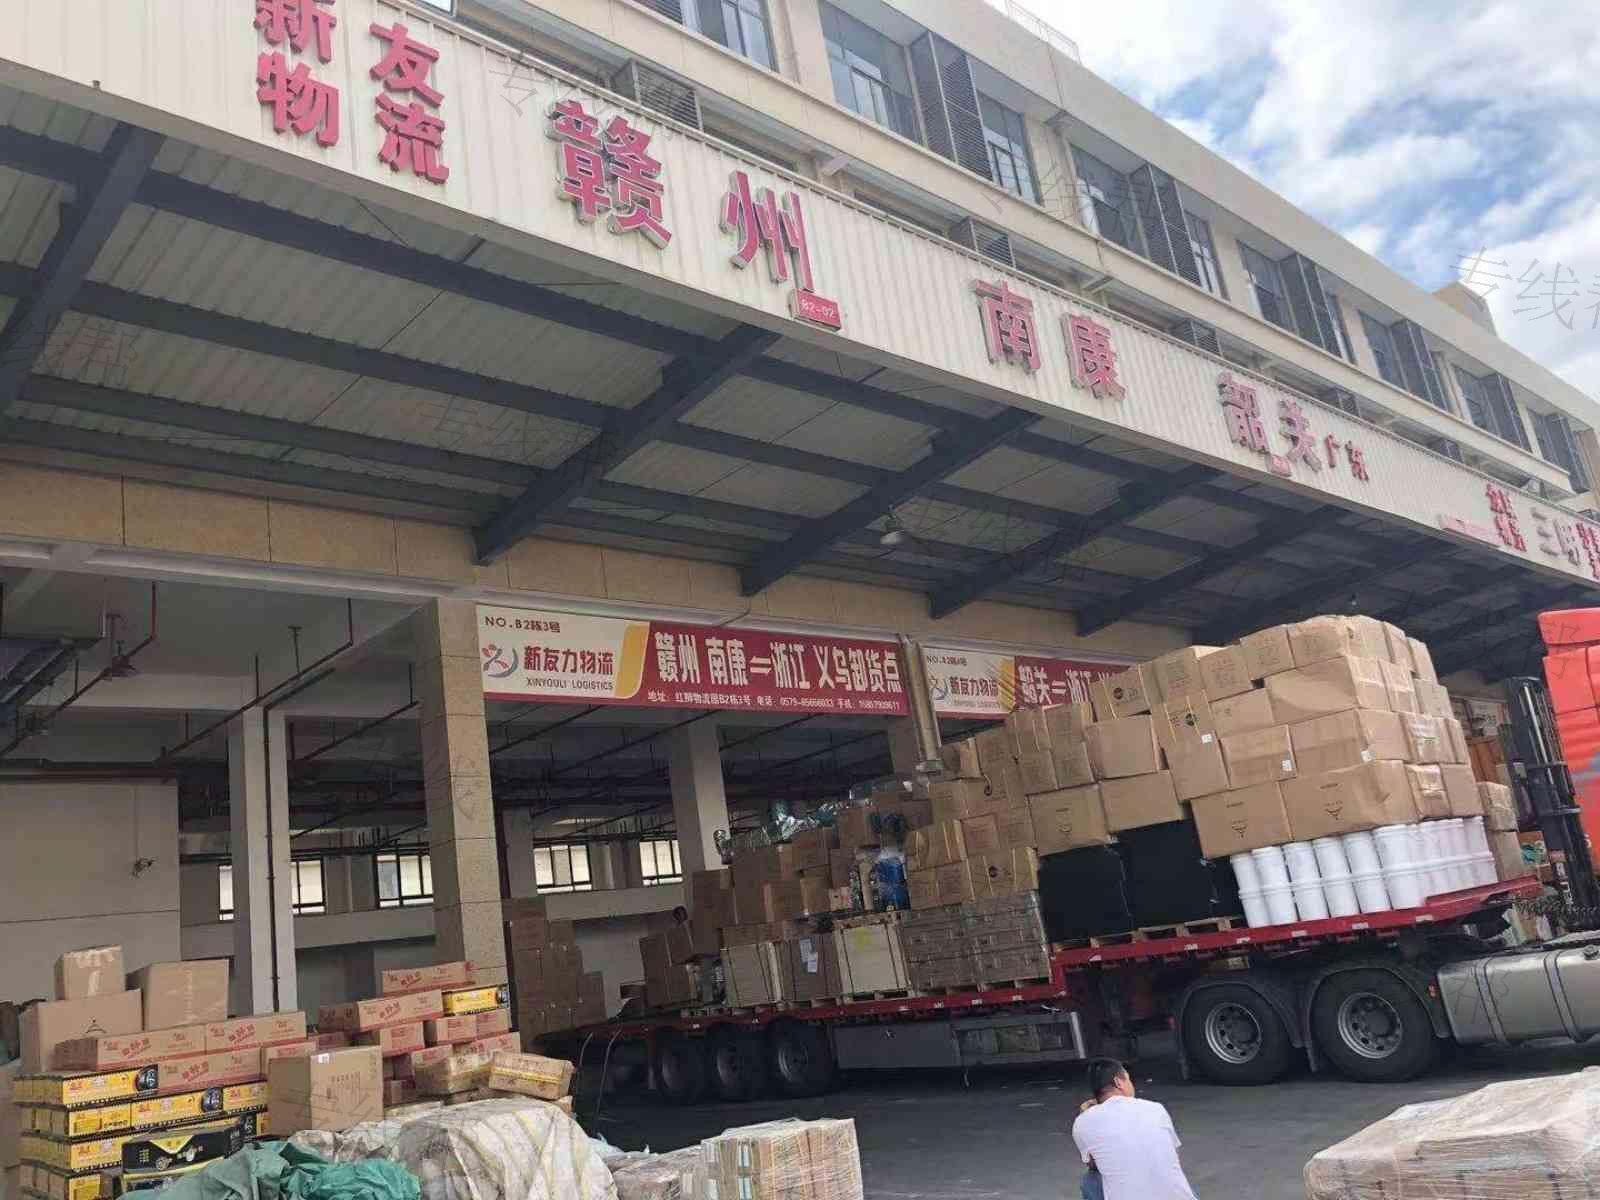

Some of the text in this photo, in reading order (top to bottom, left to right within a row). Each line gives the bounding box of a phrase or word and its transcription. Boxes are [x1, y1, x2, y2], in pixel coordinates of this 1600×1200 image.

[546, 99, 814, 292] 赣州
[970, 279, 1126, 400] 南康
[1217, 370, 1322, 472] 韶关
[524, 645, 613, 675] 新友力物流
[572, 678, 613, 690] LOGISTICS
[655, 631, 700, 684] 赣州
[705, 636, 749, 686] 南康
[769, 641, 811, 689] 浙江
